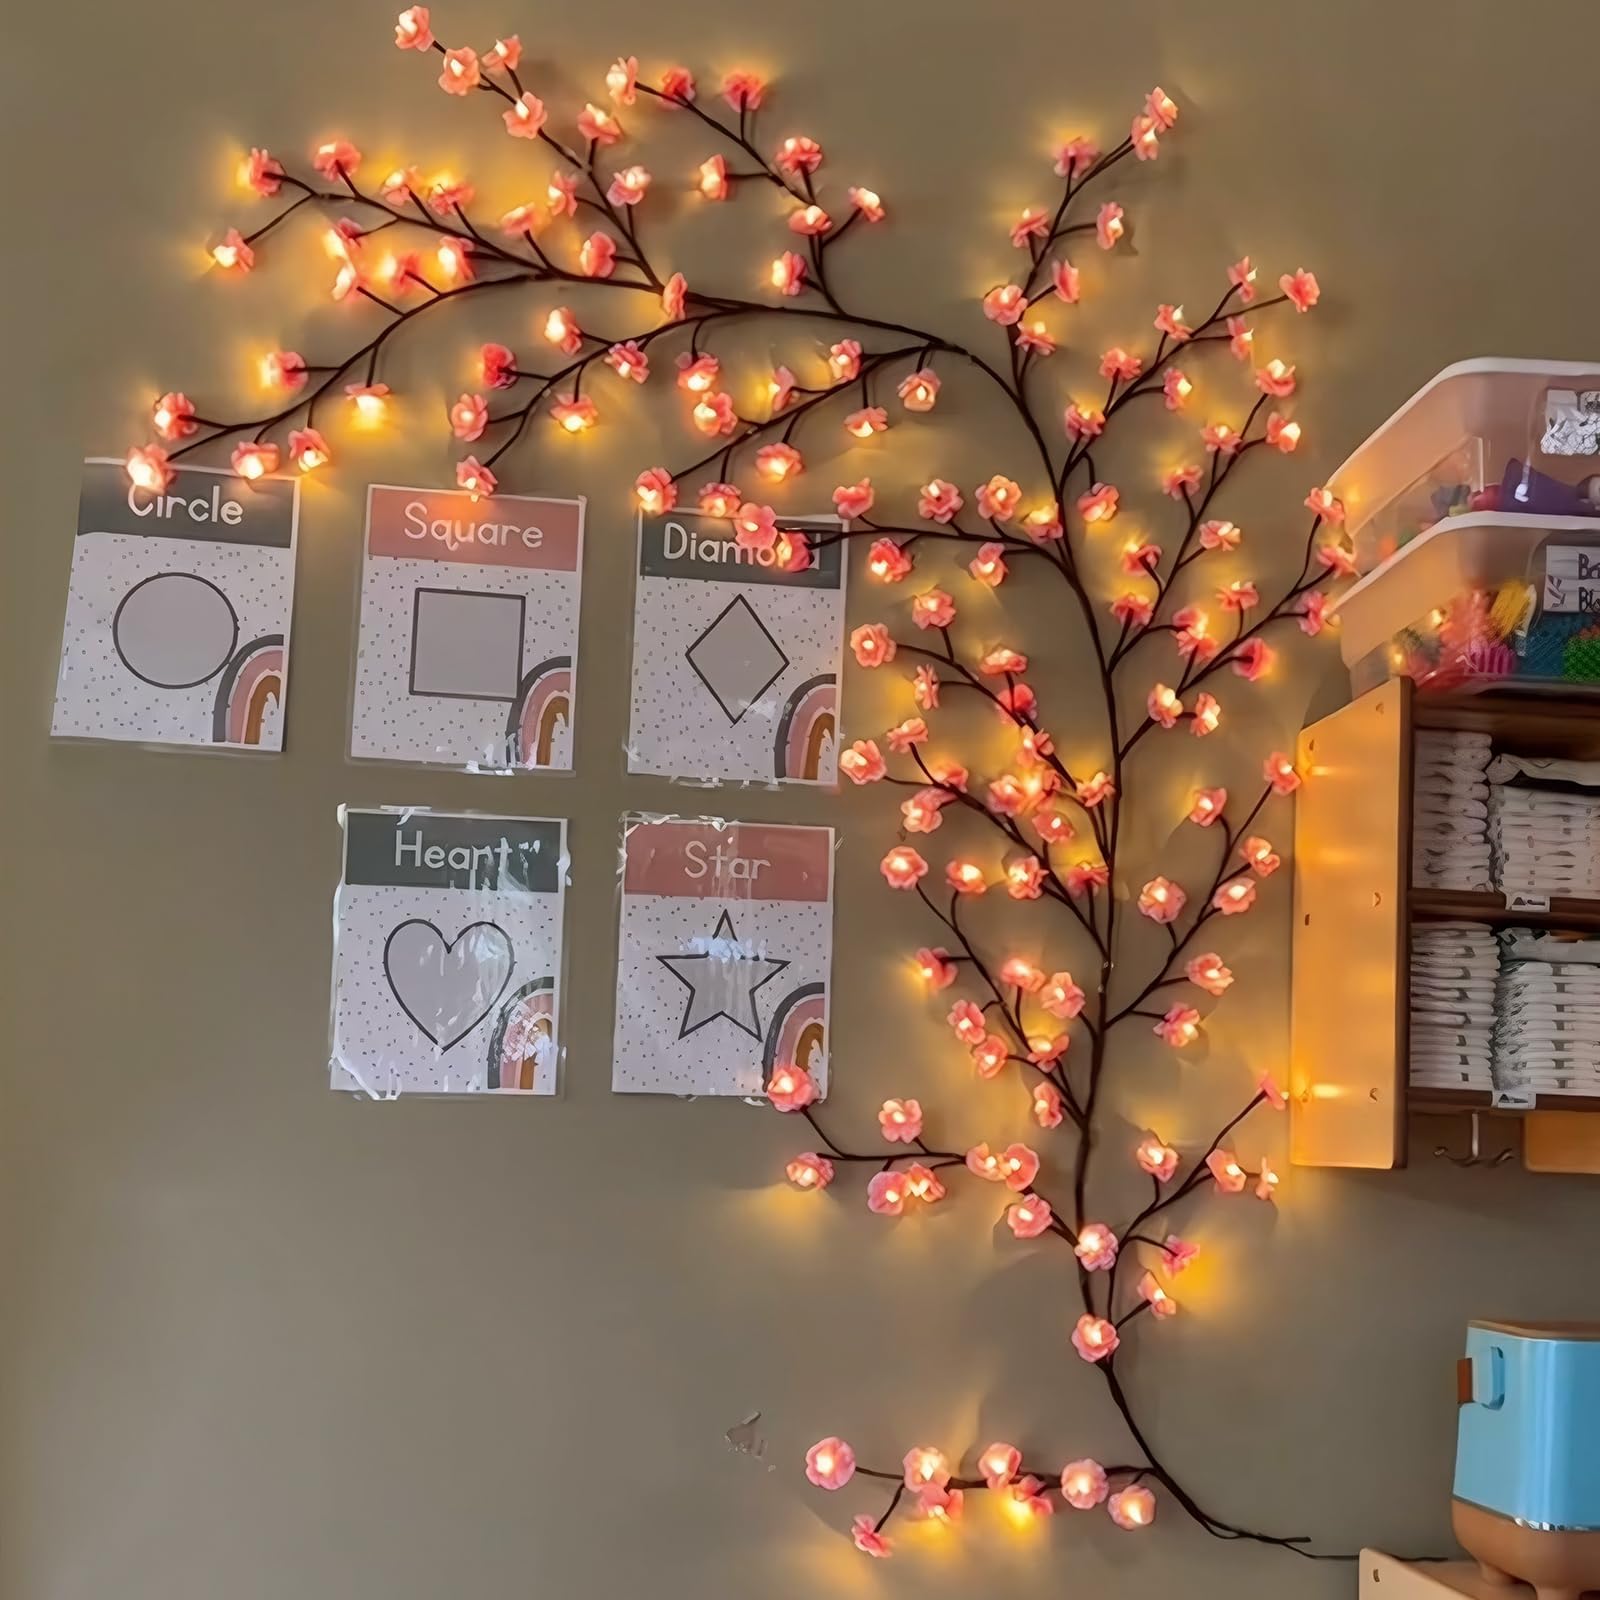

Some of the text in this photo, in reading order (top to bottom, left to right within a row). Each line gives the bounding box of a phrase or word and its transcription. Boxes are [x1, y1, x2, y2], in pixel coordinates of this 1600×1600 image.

[128, 484, 243, 525] Circle
[404, 502, 544, 551] Square
[663, 522, 821, 570] Diamod
[395, 830, 513, 871] Heart
[684, 841, 771, 880] Star
